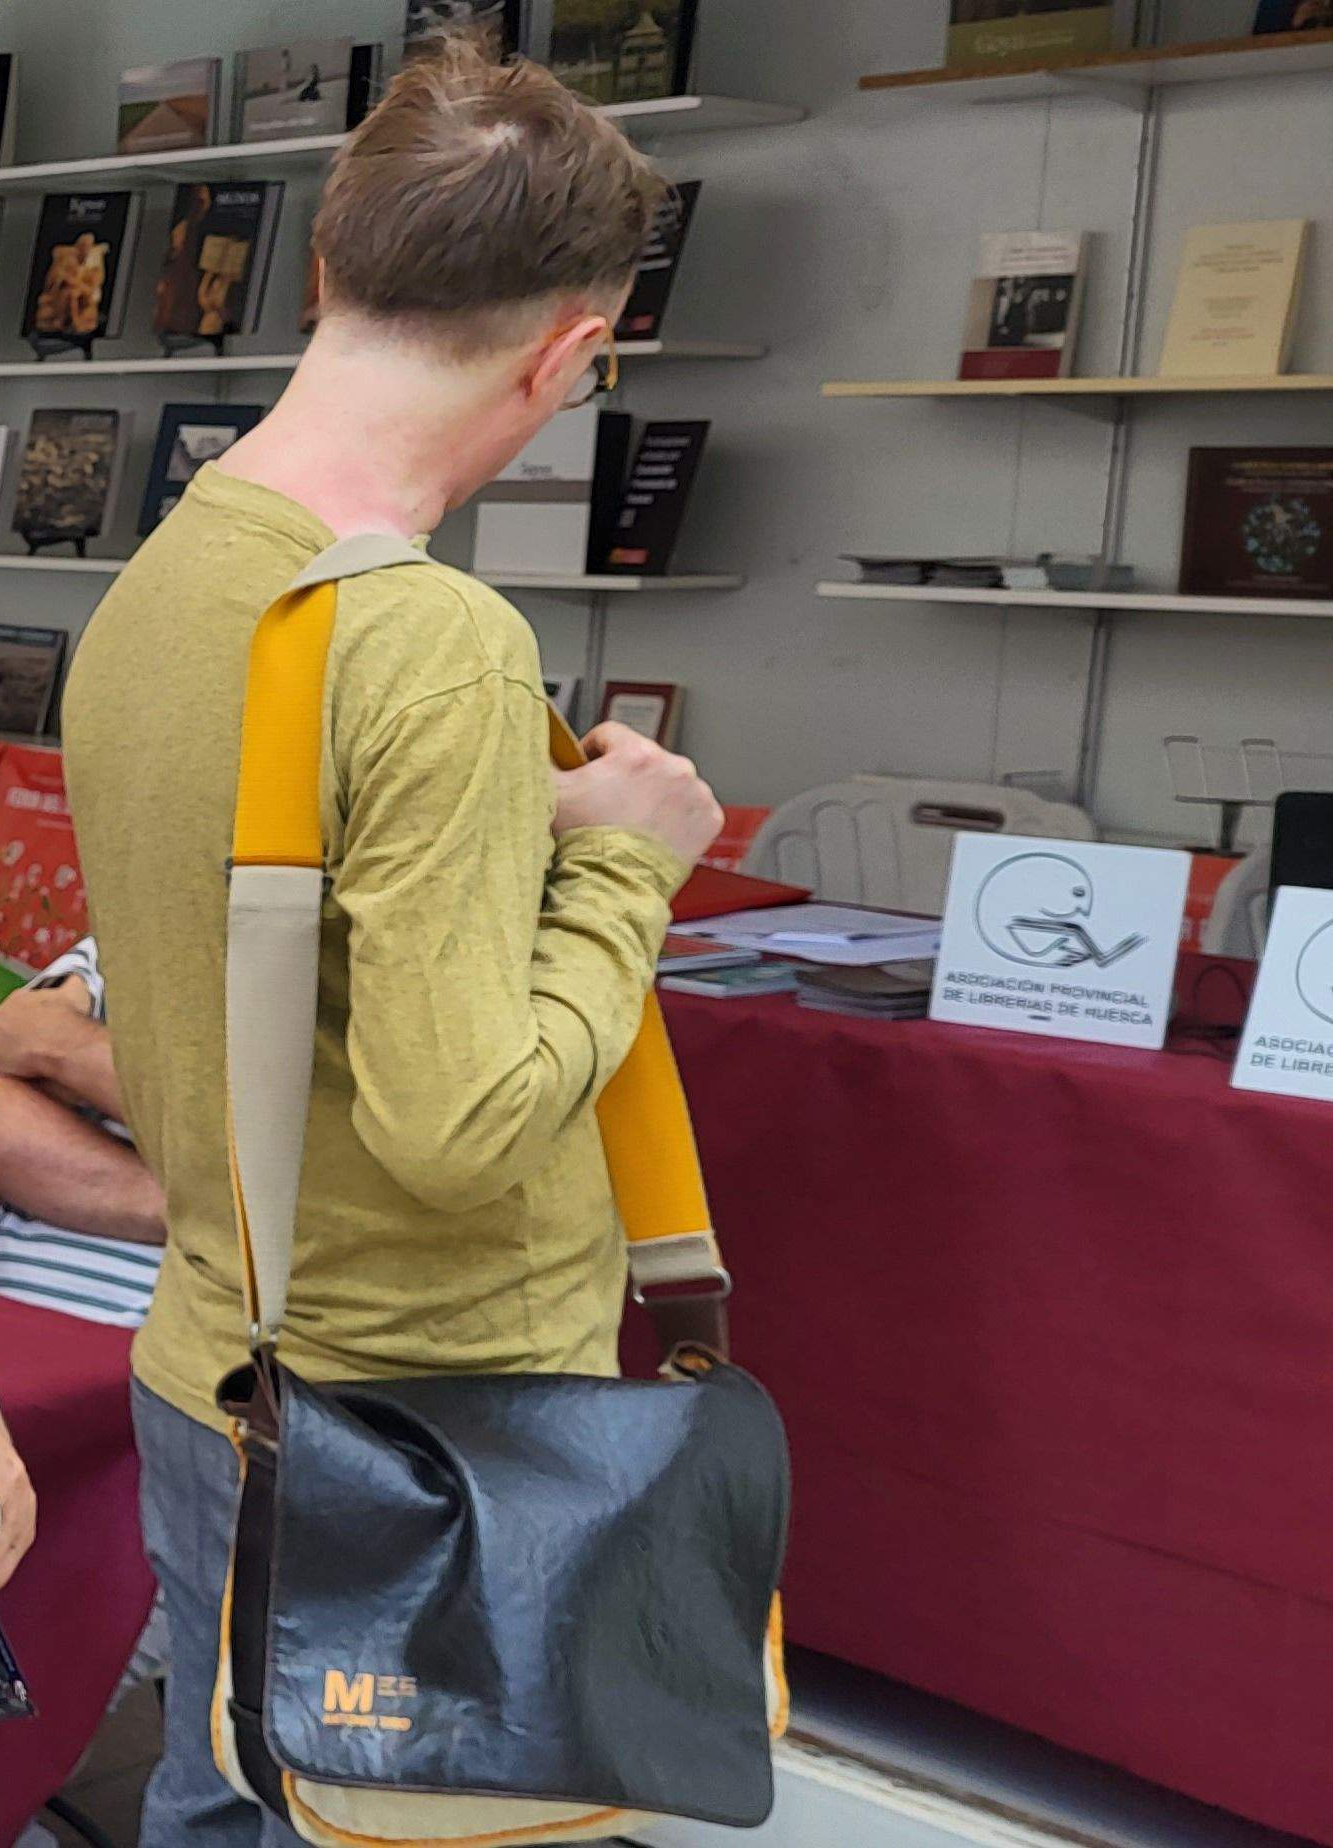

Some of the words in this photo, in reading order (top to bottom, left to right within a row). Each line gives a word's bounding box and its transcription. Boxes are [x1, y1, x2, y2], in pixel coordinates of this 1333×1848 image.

[943, 987, 965, 1003] DE
[1057, 1000, 1081, 1017] DE
[1085, 1007, 1154, 1027] HUESCA
[1050, 982, 1152, 1009] PROVINCIAL
[1251, 1052, 1276, 1069] DE
[323, 1669, 374, 1714] M
